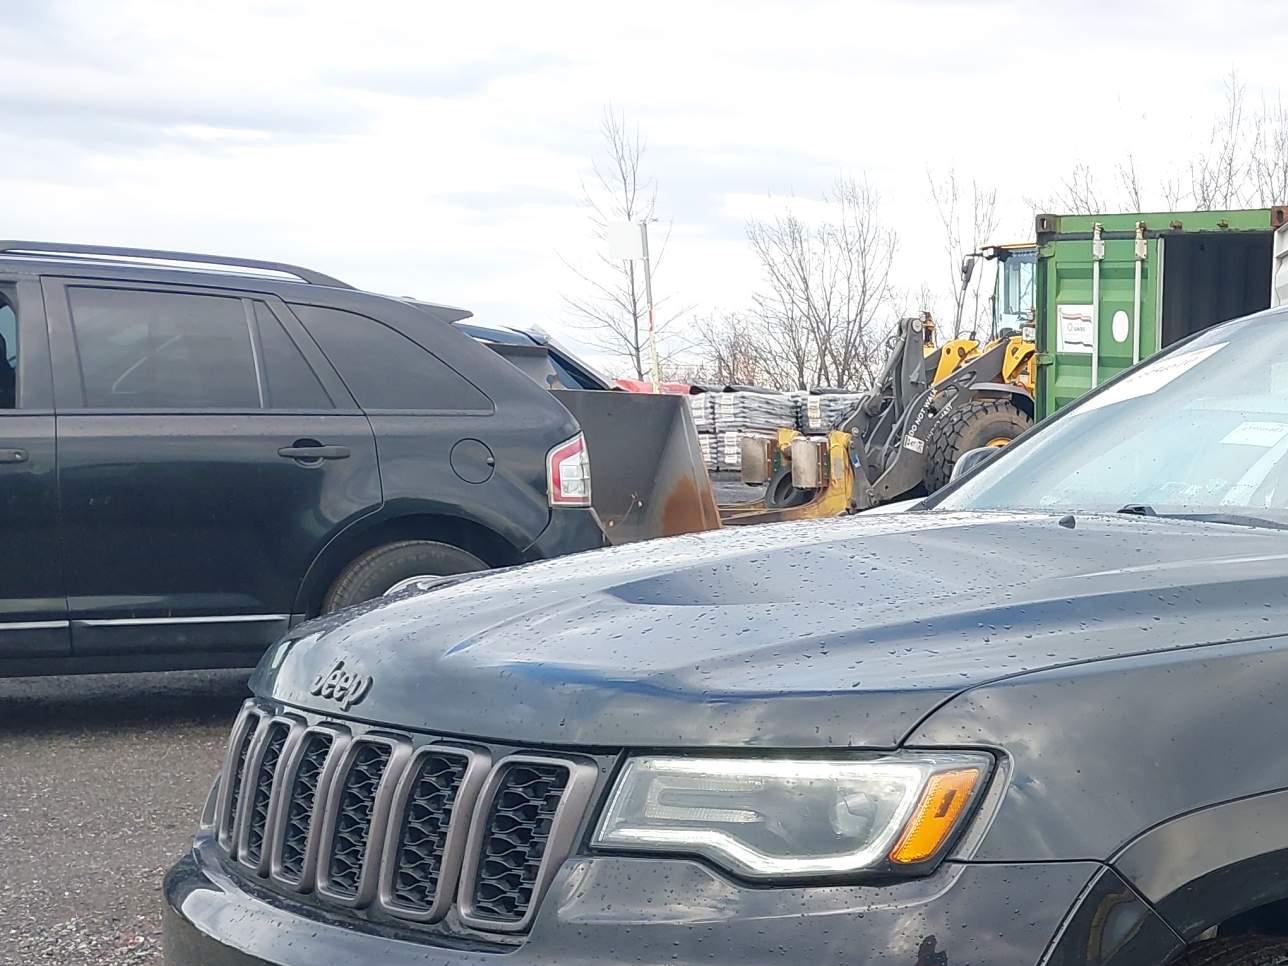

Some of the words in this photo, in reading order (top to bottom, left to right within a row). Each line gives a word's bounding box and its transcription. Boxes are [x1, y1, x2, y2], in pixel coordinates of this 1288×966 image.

[908, 424, 918, 437] DO
[914, 407, 926, 426] NOT
[310, 659, 374, 713] Jeep
